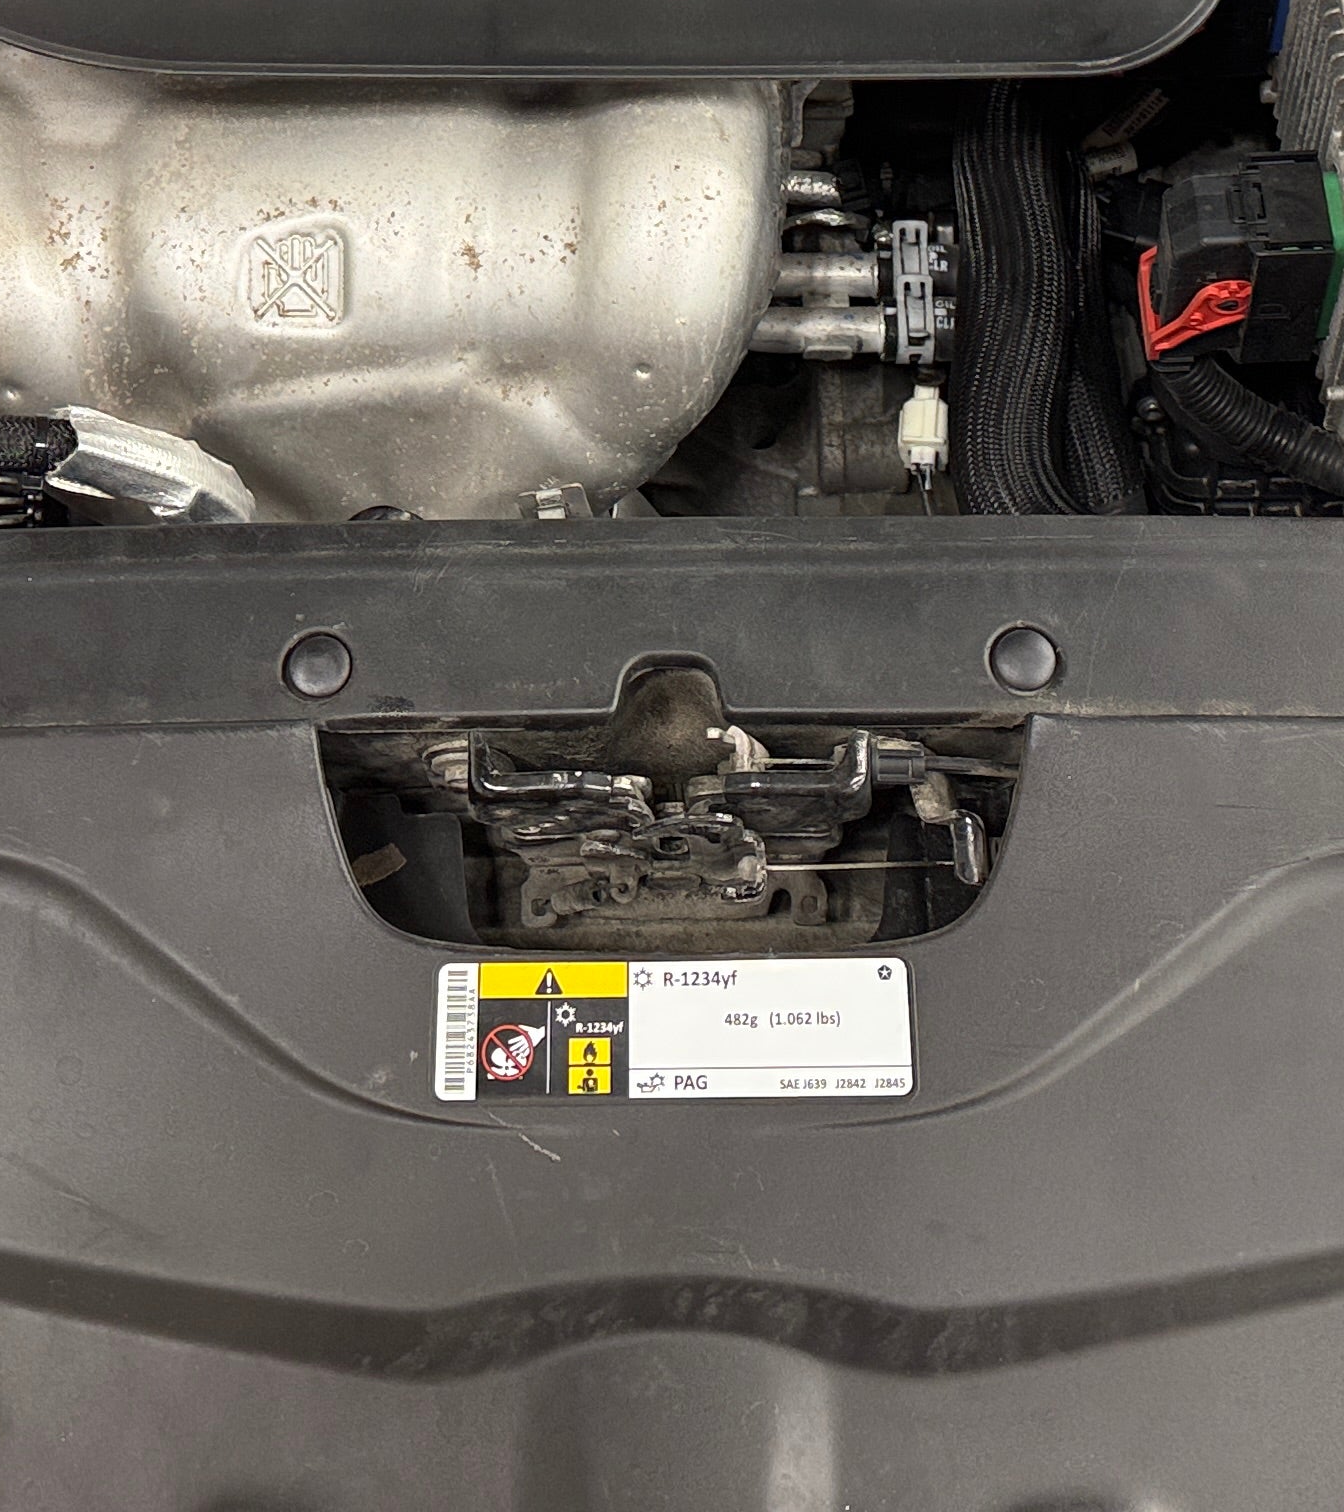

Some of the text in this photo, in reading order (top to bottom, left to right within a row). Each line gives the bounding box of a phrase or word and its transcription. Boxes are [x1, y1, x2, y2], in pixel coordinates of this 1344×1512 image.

[935, 300, 956, 309] OIL
[662, 969, 738, 988] R-1234yf
[725, 1011, 841, 1028] 482g (1.062 lbs)
[575, 1021, 624, 1036] R-1234yf
[674, 1075, 708, 1090] PAG
[780, 1078, 906, 1090] SAE J639 J2842 J2845
